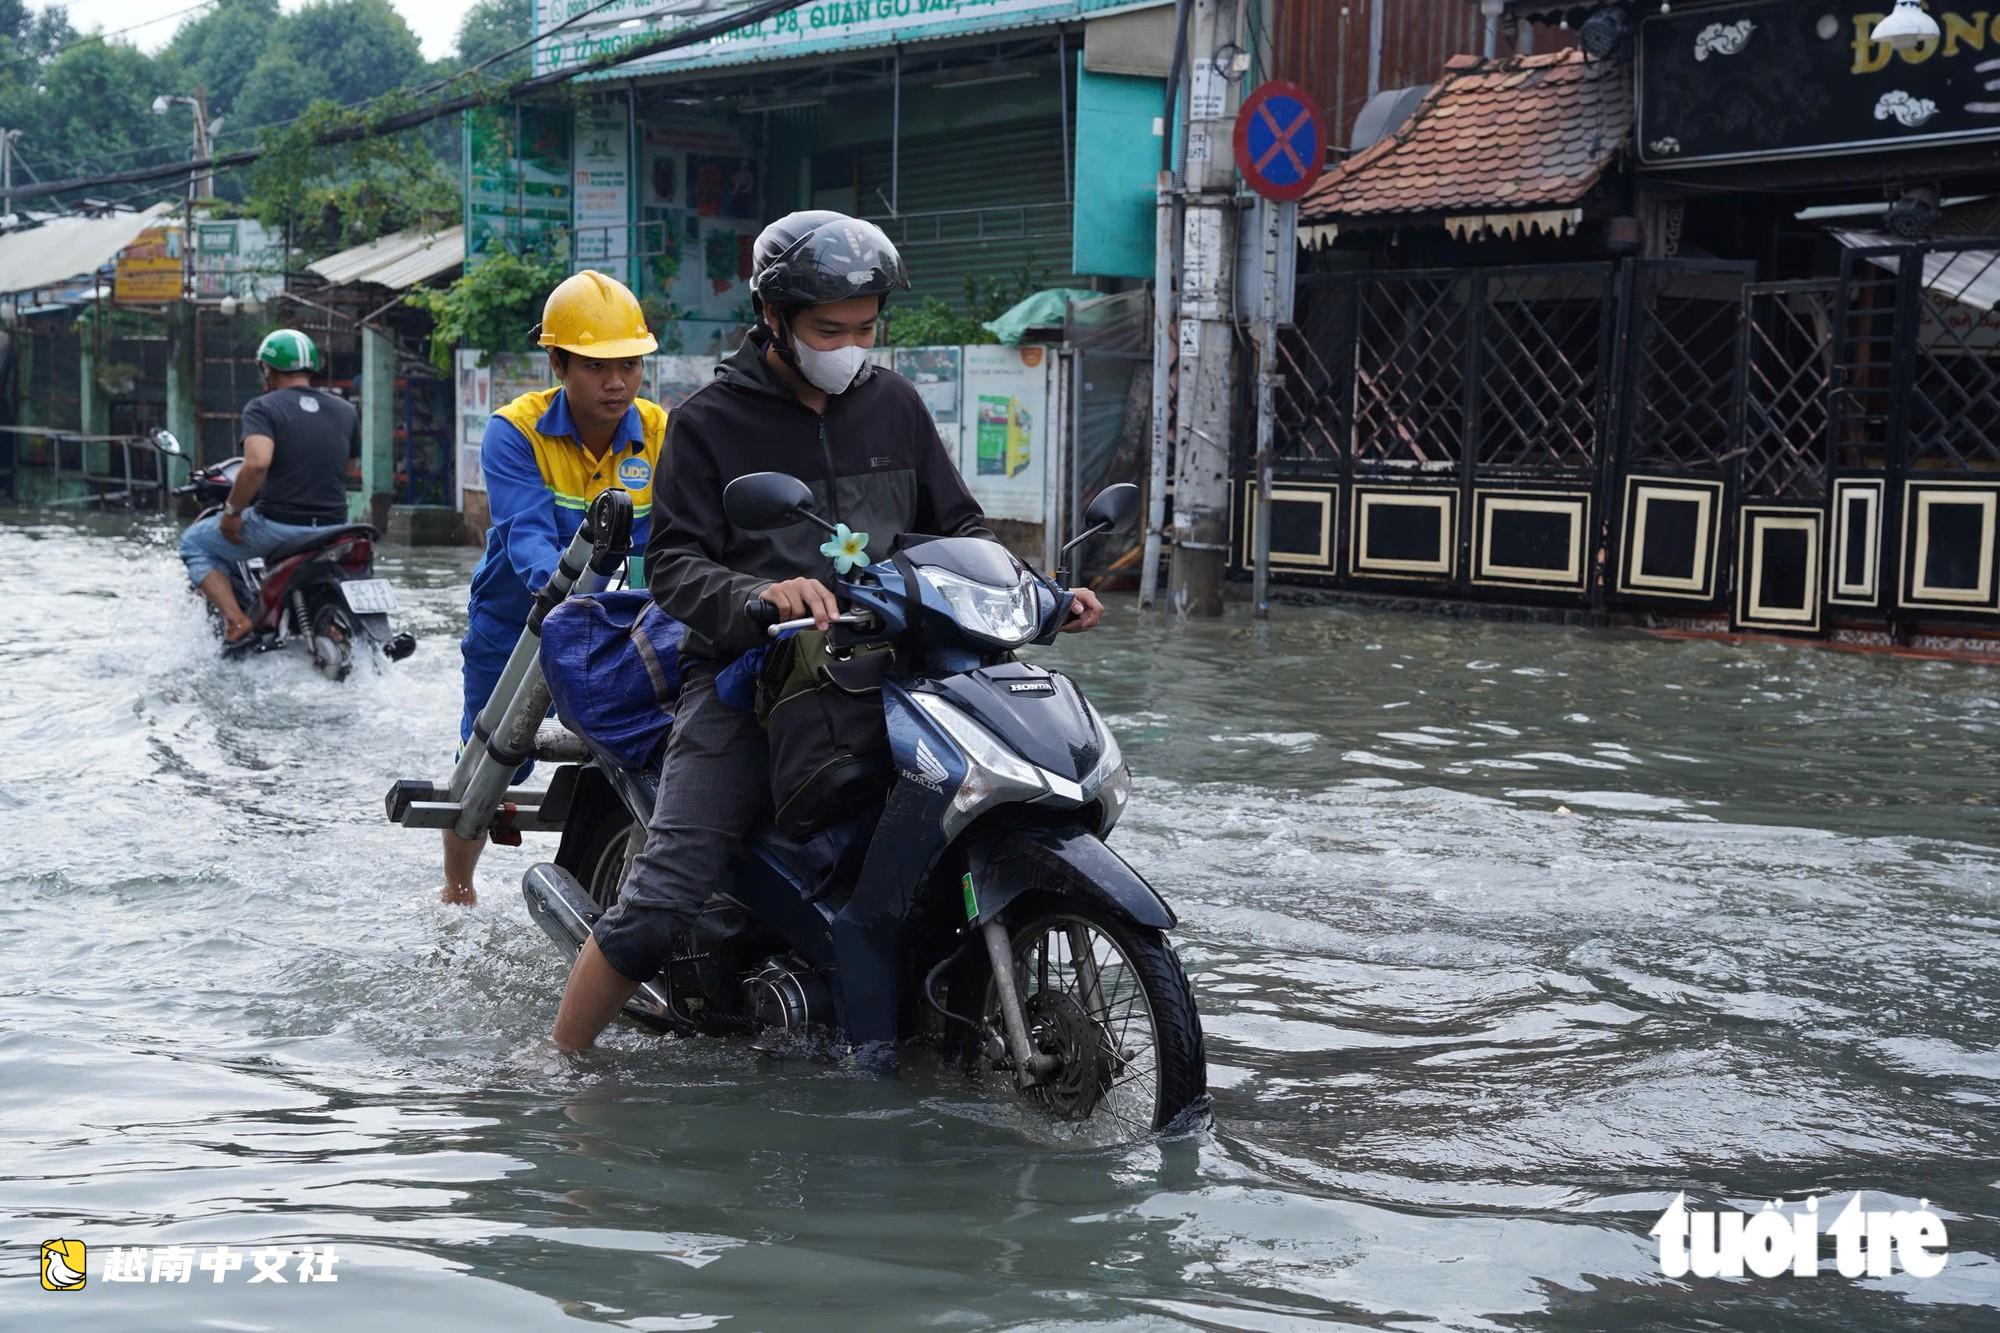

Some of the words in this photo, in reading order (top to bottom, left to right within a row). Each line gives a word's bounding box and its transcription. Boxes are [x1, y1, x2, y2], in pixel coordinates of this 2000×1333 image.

[621, 466, 649, 478] UDC
[1010, 683, 1053, 691] HONDA
[902, 769, 944, 795] HONDA
